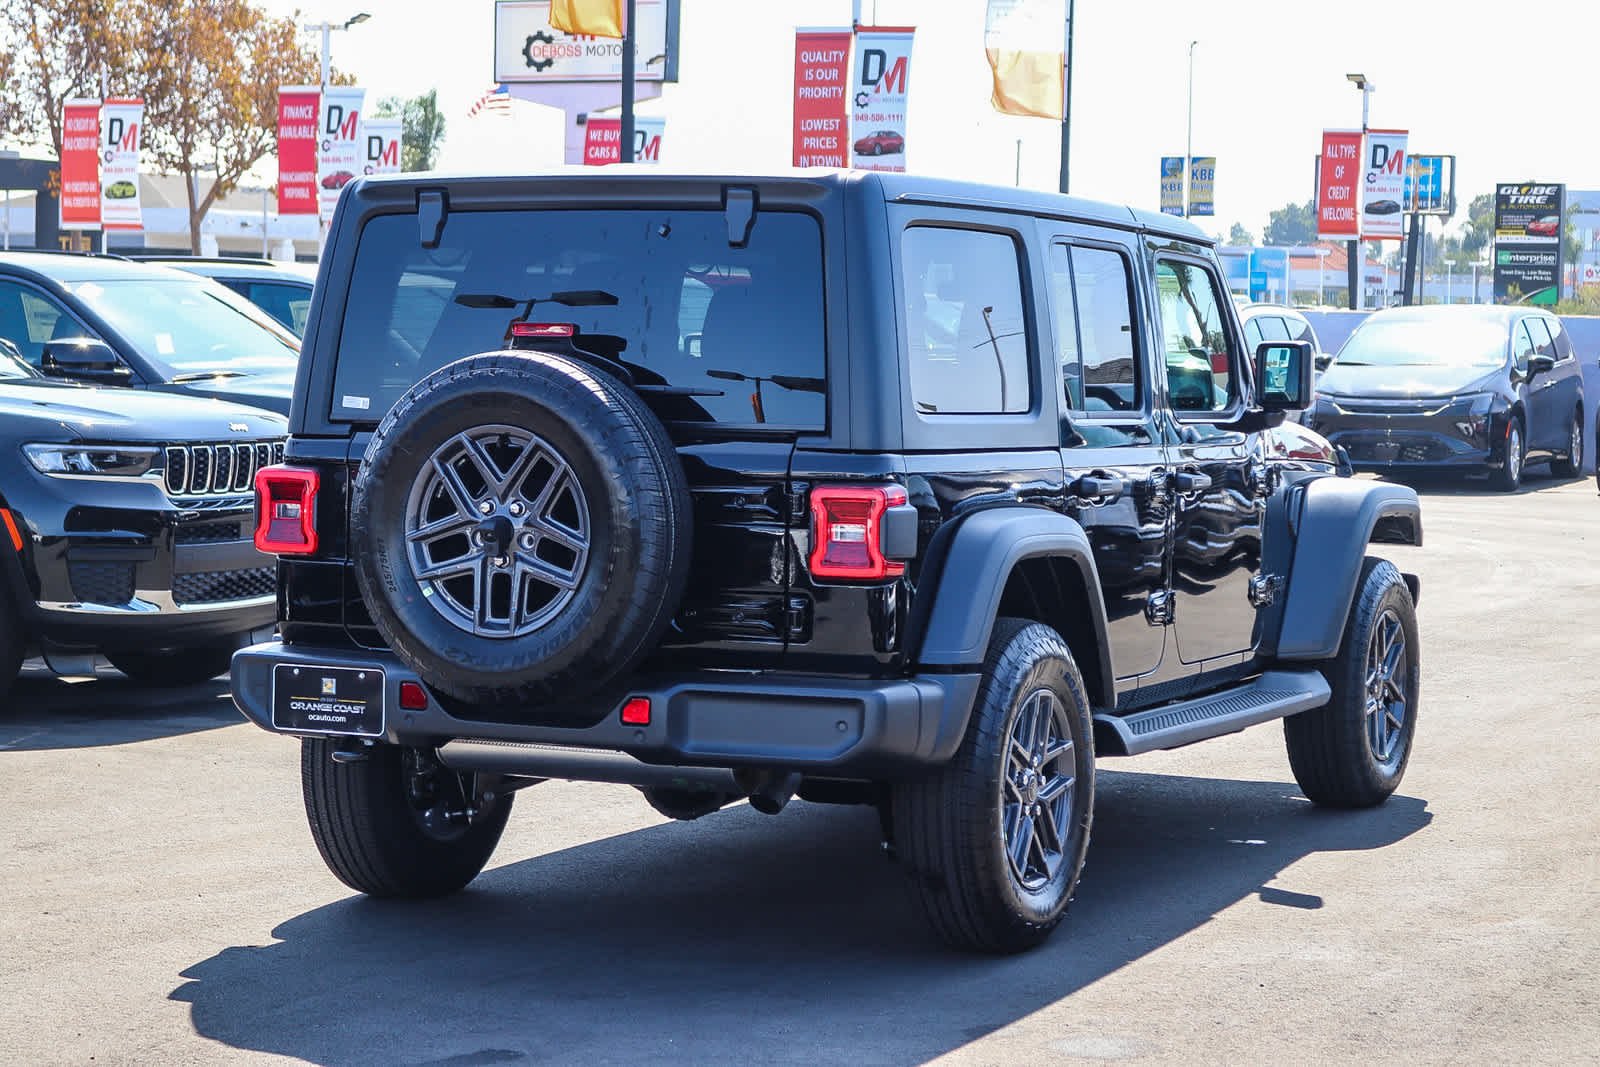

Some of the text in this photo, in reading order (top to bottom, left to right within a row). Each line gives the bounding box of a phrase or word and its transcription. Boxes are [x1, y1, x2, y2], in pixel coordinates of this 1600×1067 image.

[532, 45, 582, 57] DEBOSS
[801, 51, 845, 64] QUALITY
[805, 69, 838, 80] IS OUR
[861, 49, 908, 94] DM
[799, 87, 843, 98] PRIORITY
[283, 105, 313, 118] FINANCE
[326, 105, 358, 141] DM
[801, 119, 840, 131] LOWEST
[108, 118, 138, 153] DM
[280, 125, 315, 138] AVAILABLE
[590, 130, 620, 141] WE BUY
[803, 137, 837, 149] PRICES
[367, 136, 398, 167] DM
[588, 147, 609, 158] CARS
[1327, 145, 1356, 158] ALL TYPE
[800, 156, 842, 167] IN TOWN
[1371, 144, 1404, 175] DM
[1335, 166, 1344, 178] OF
[1328, 187, 1350, 199] CREDIT
[1500, 186, 1558, 195] GLOBE
[1510, 195, 1548, 204] TIRE
[1323, 208, 1355, 221] WELCOME
[1501, 253, 1555, 264] enterprise
[290, 702, 366, 714] ORANGE COAST
[308, 714, 347, 723] ocauto.com
